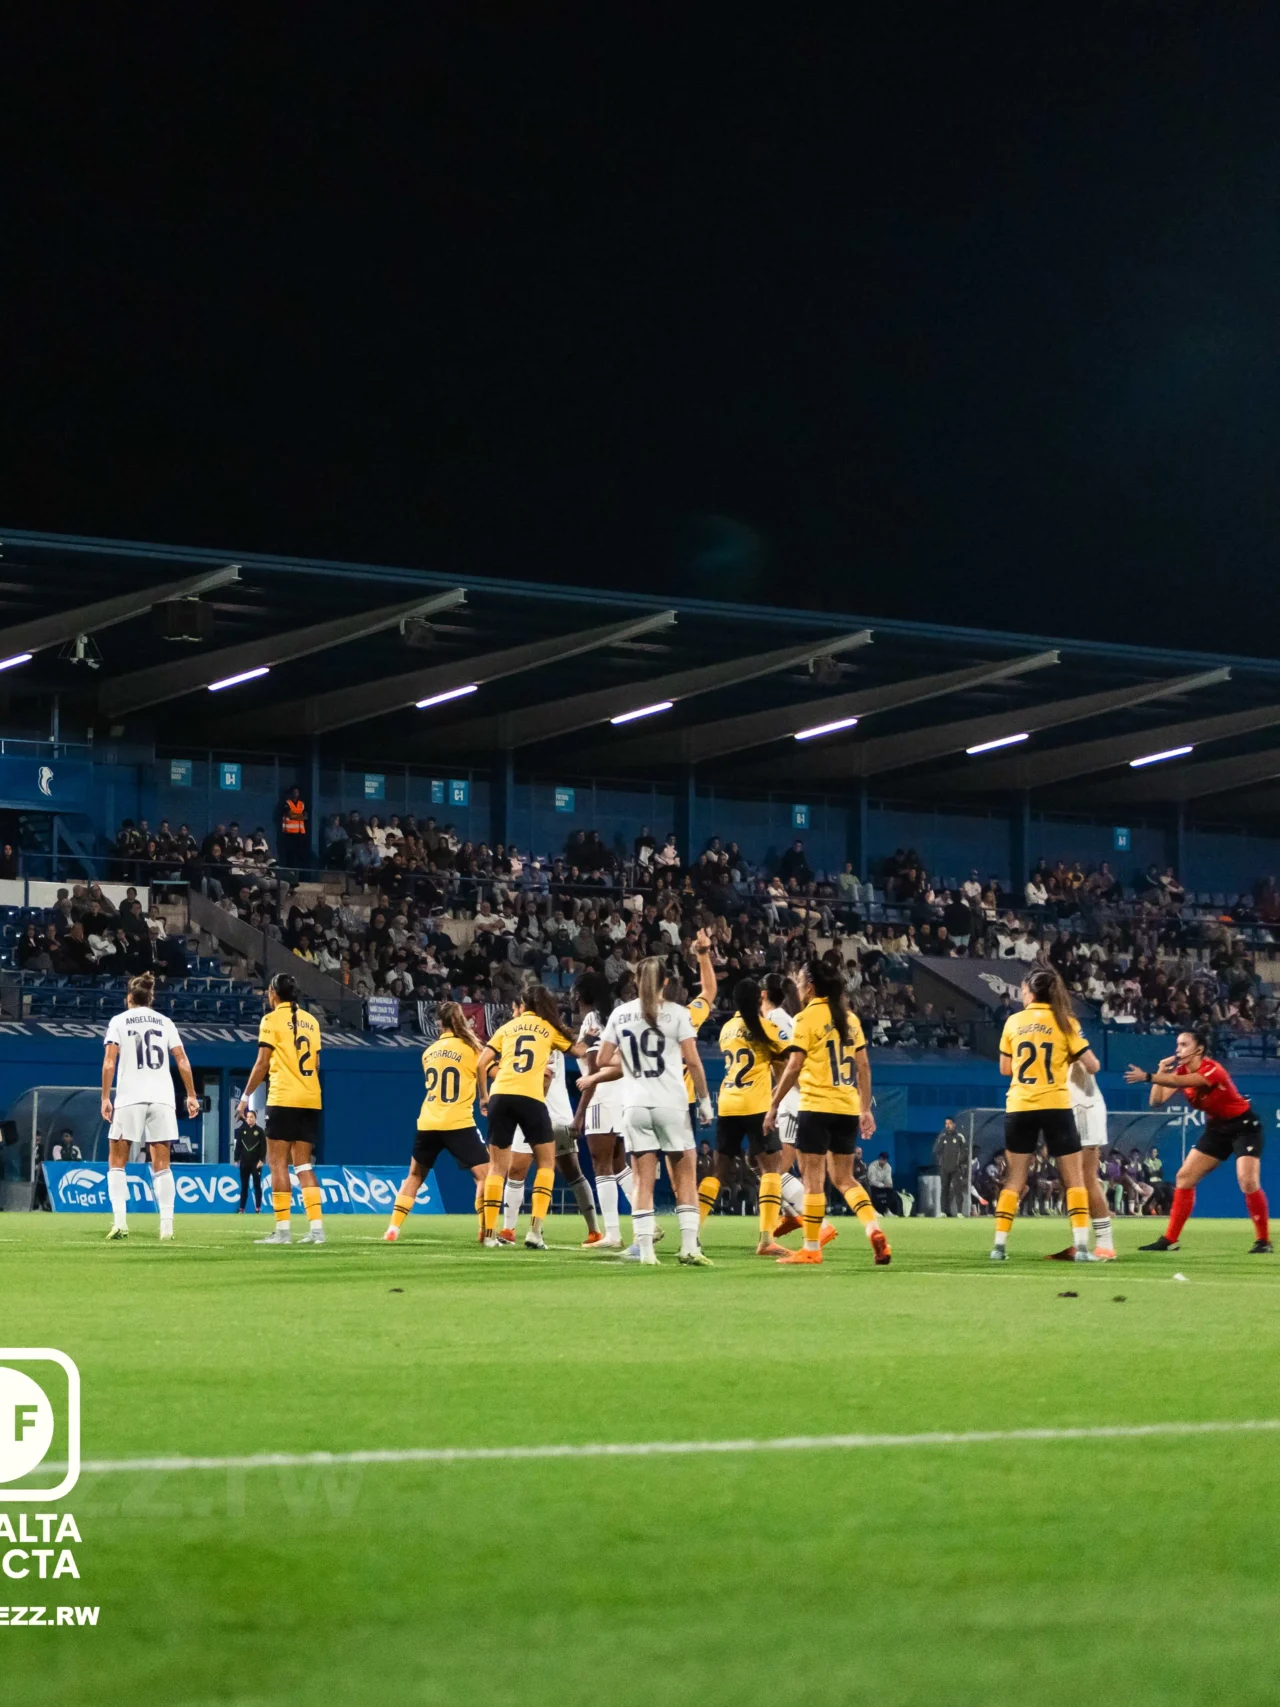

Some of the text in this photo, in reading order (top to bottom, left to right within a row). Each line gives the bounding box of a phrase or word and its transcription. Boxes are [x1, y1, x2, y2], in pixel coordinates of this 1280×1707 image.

[127, 1028, 164, 1070] 16
[513, 1023, 550, 1039] VALLEJO
[295, 1035, 314, 1077] 2
[512, 1034, 536, 1074] 5
[621, 1026, 666, 1079] 19
[723, 1047, 756, 1089] 22
[825, 1038, 858, 1087] 15
[1016, 1040, 1055, 1085] 21
[425, 1066, 461, 1104] 20
[67, 1190, 107, 1207] Liga F
